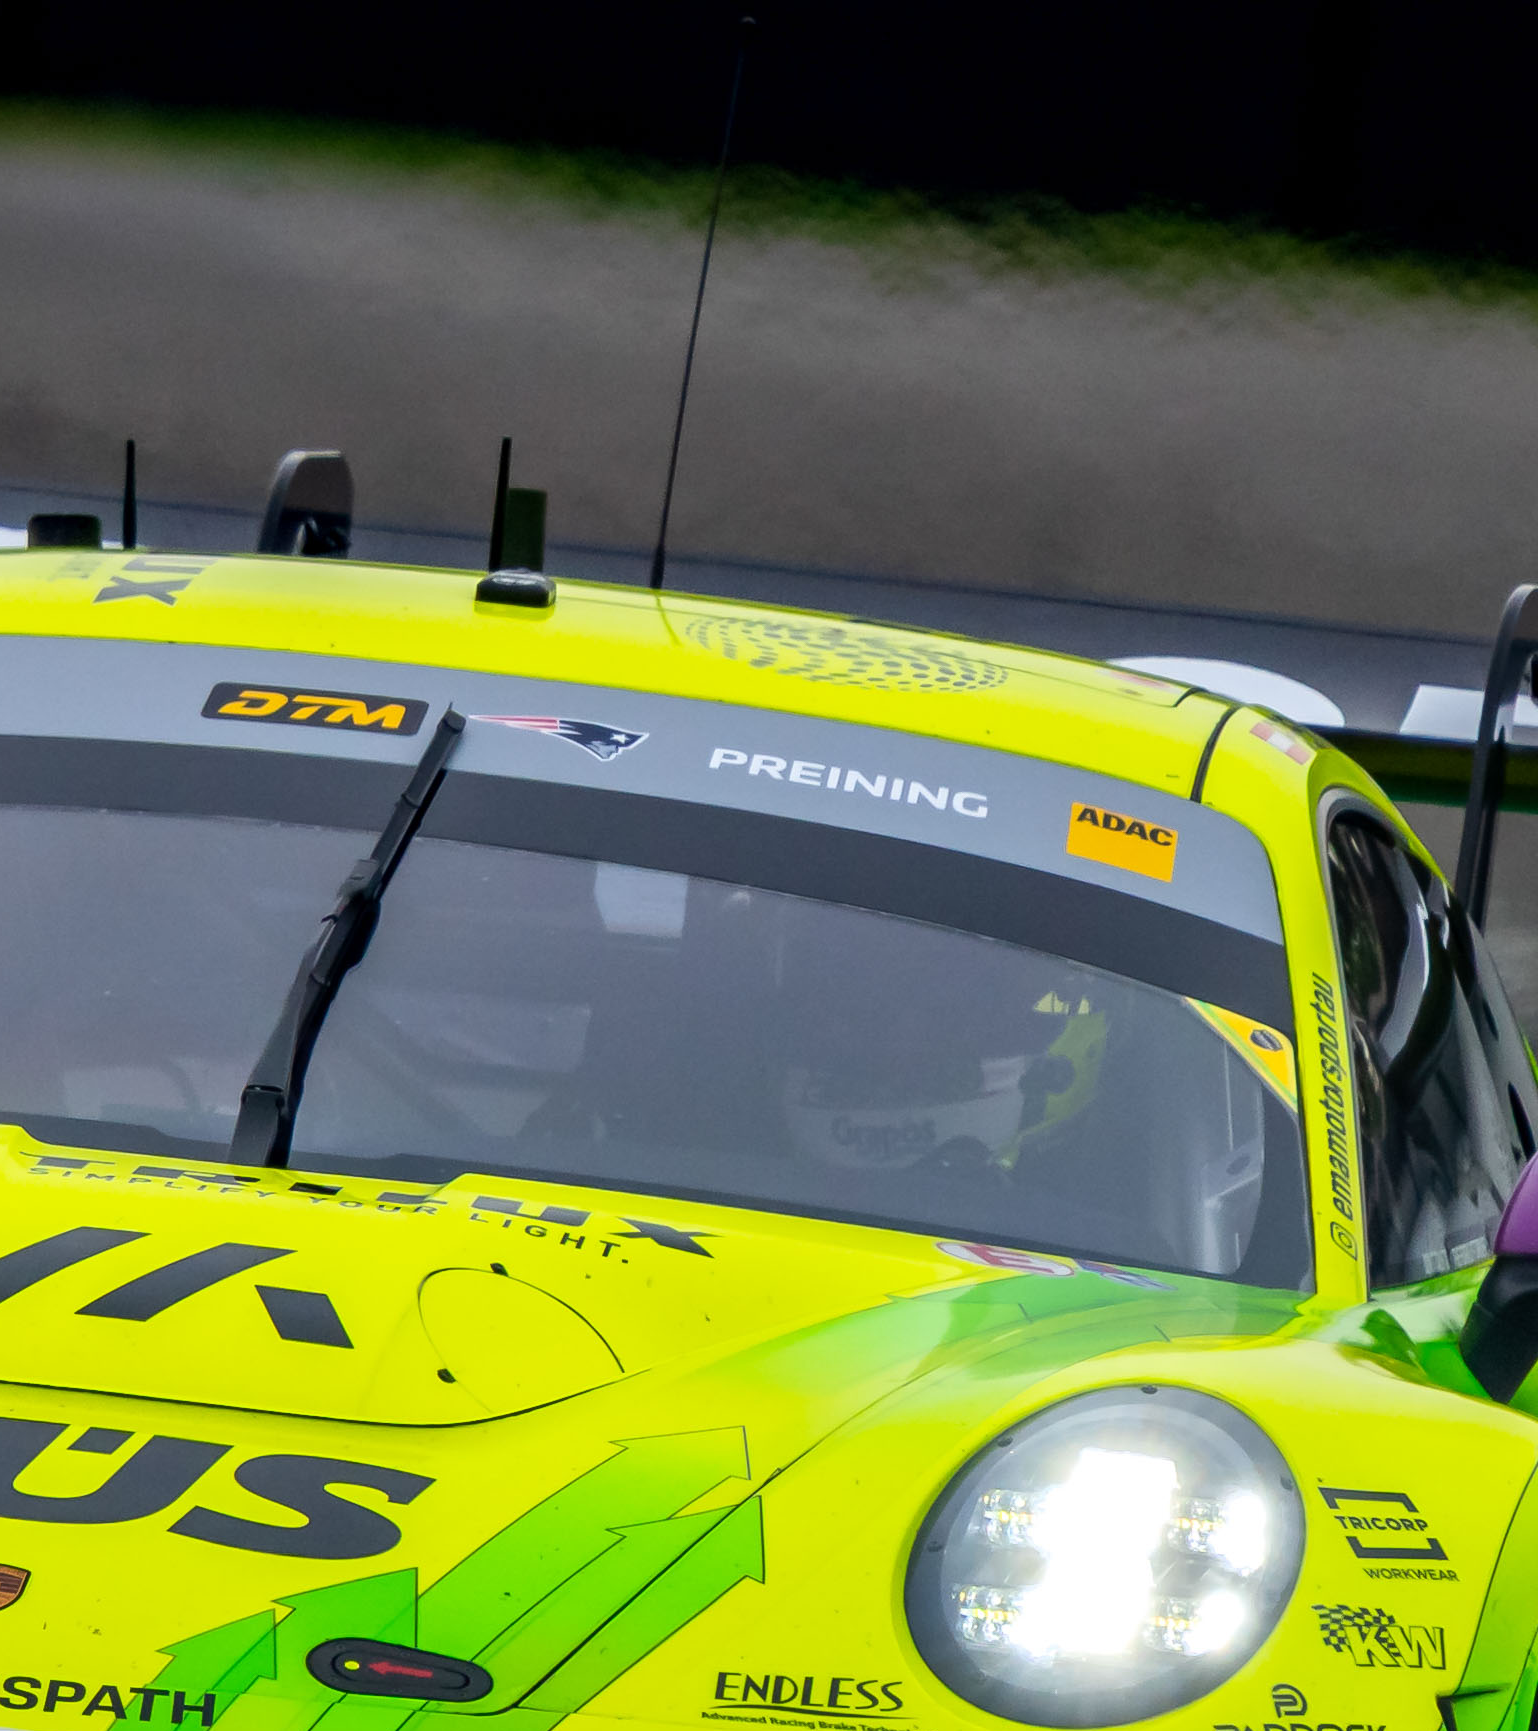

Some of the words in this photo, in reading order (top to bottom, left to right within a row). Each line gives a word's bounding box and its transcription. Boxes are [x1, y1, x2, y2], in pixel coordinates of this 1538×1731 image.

[217, 689, 407, 730] DTM
[709, 747, 989, 819] PREINING
[1076, 807, 1174, 849] ADAC
[1310, 972, 1354, 1221] emamotorsportau
[27, 1166, 277, 1198] SIMPLIFY
[309, 1196, 439, 1216] YOUR
[469, 1212, 629, 1264] LIGHT.
[1334, 1515, 1429, 1532] TRICORP
[1362, 1568, 1460, 1582] WORKWEAR
[1344, 1622, 1447, 1670] KW
[714, 1671, 904, 1712] ENDLESS
[701, 1711, 767, 1725] Advanced
[770, 1717, 817, 1730] Racing
